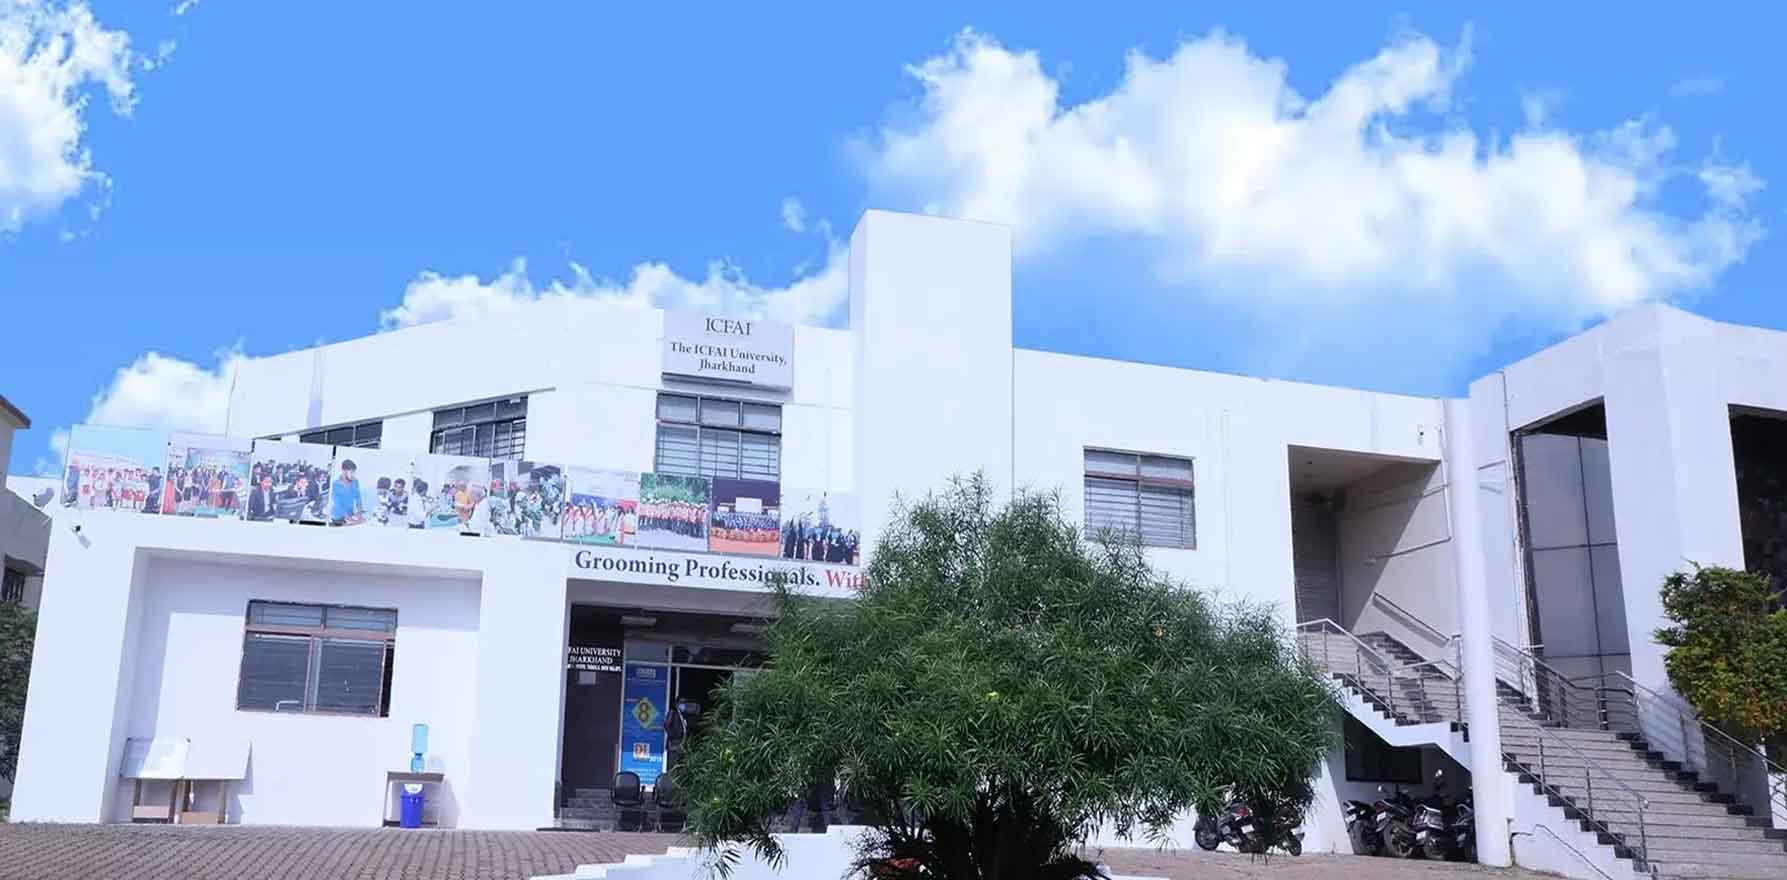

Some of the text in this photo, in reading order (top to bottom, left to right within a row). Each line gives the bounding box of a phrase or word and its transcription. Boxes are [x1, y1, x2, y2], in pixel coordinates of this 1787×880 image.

[705, 318, 751, 336] ICFAI
[670, 341, 787, 366] The ICFAI University,
[698, 358, 756, 374] Jharkhand
[575, 550, 680, 582] Grooming
[580, 647, 622, 657] UNIVERSITY
